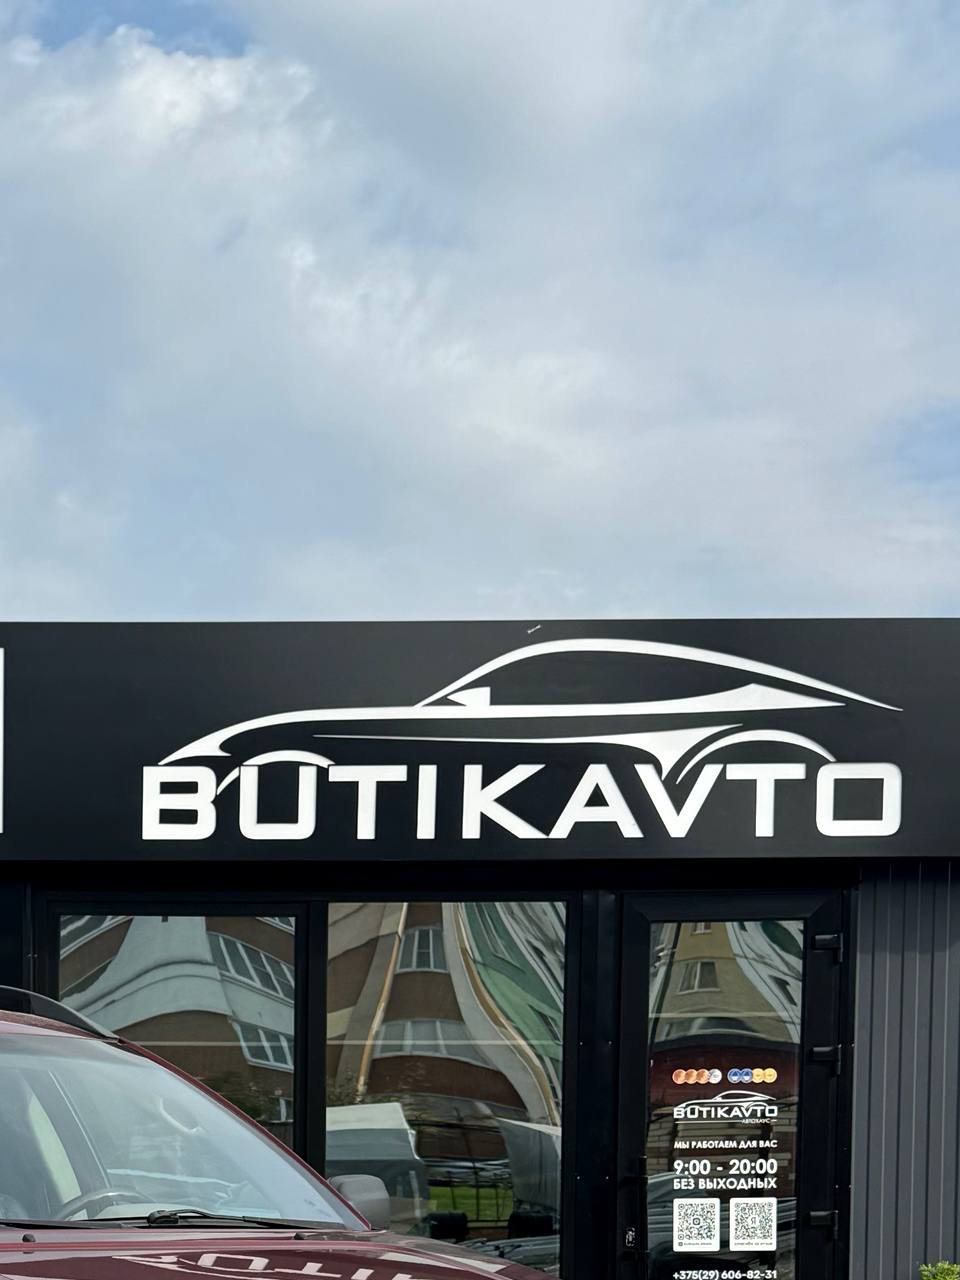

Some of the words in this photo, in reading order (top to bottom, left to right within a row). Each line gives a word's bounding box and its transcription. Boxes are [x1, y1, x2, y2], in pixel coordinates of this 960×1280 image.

[142, 761, 902, 841] BUTIKAVTO
[673, 1106, 778, 1119] BUTIKAVTO
[674, 1141, 690, 1149] МЫ
[691, 1140, 737, 1149] РАБОТАЕМ
[738, 1140, 757, 1149] ДЛЯ
[759, 1140, 778, 1148] ВАС
[673, 1160, 711, 1175] 9:00
[729, 1159, 778, 1175] 20:00
[673, 1178, 695, 1190] БЕЗ
[698, 1177, 778, 1190] ВЫХОДНЫХ
[673, 1269, 719, 1280] +375(29)
[721, 1269, 778, 1280] 606-82-31
